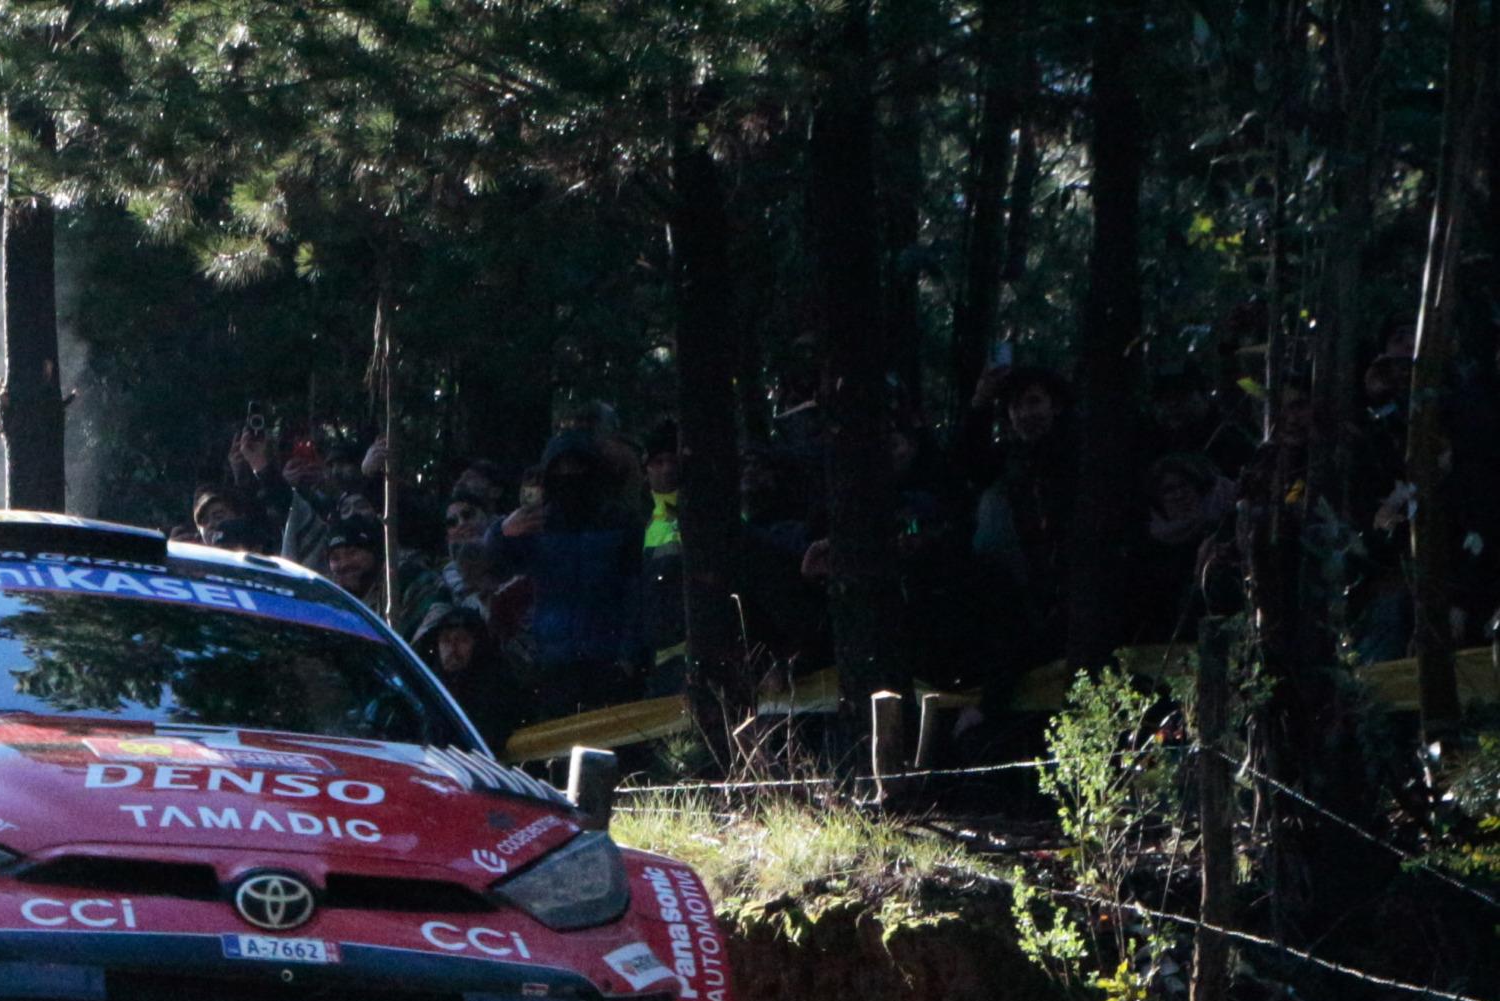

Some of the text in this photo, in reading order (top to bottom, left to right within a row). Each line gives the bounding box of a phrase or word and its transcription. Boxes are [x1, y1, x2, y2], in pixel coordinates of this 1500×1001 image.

[204, 574, 295, 597] acing
[84, 763, 386, 805] DENSO
[120, 804, 382, 843] TAMADIC
[247, 938, 318, 959] A-7662
